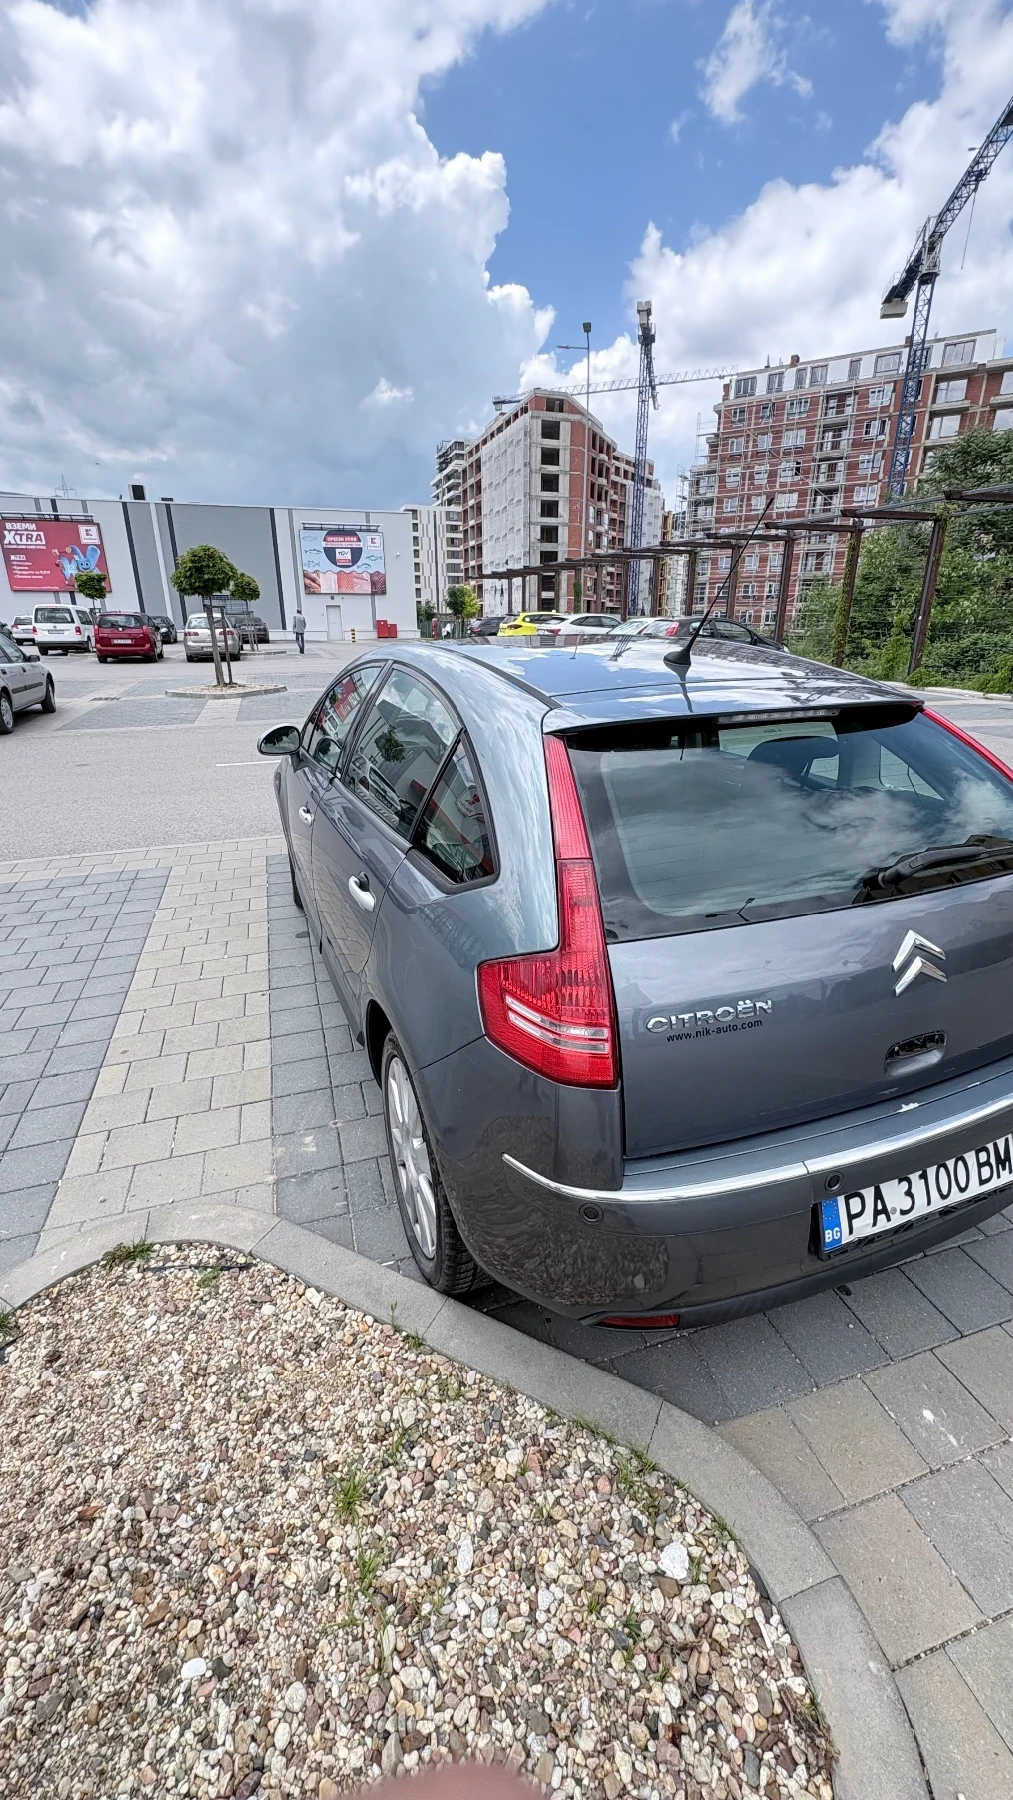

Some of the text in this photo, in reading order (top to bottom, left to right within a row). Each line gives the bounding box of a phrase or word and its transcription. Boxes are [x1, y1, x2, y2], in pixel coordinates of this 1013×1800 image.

[5, 522, 37, 531] ВЗЕМИ
[3, 530, 46, 545] XTRA
[646, 999, 773, 1033] CITROËN
[666, 1019, 763, 1043] www.nik-auto.com
[844, 1136, 1013, 1236] PA 3100 BM
[825, 1227, 842, 1243] BG
